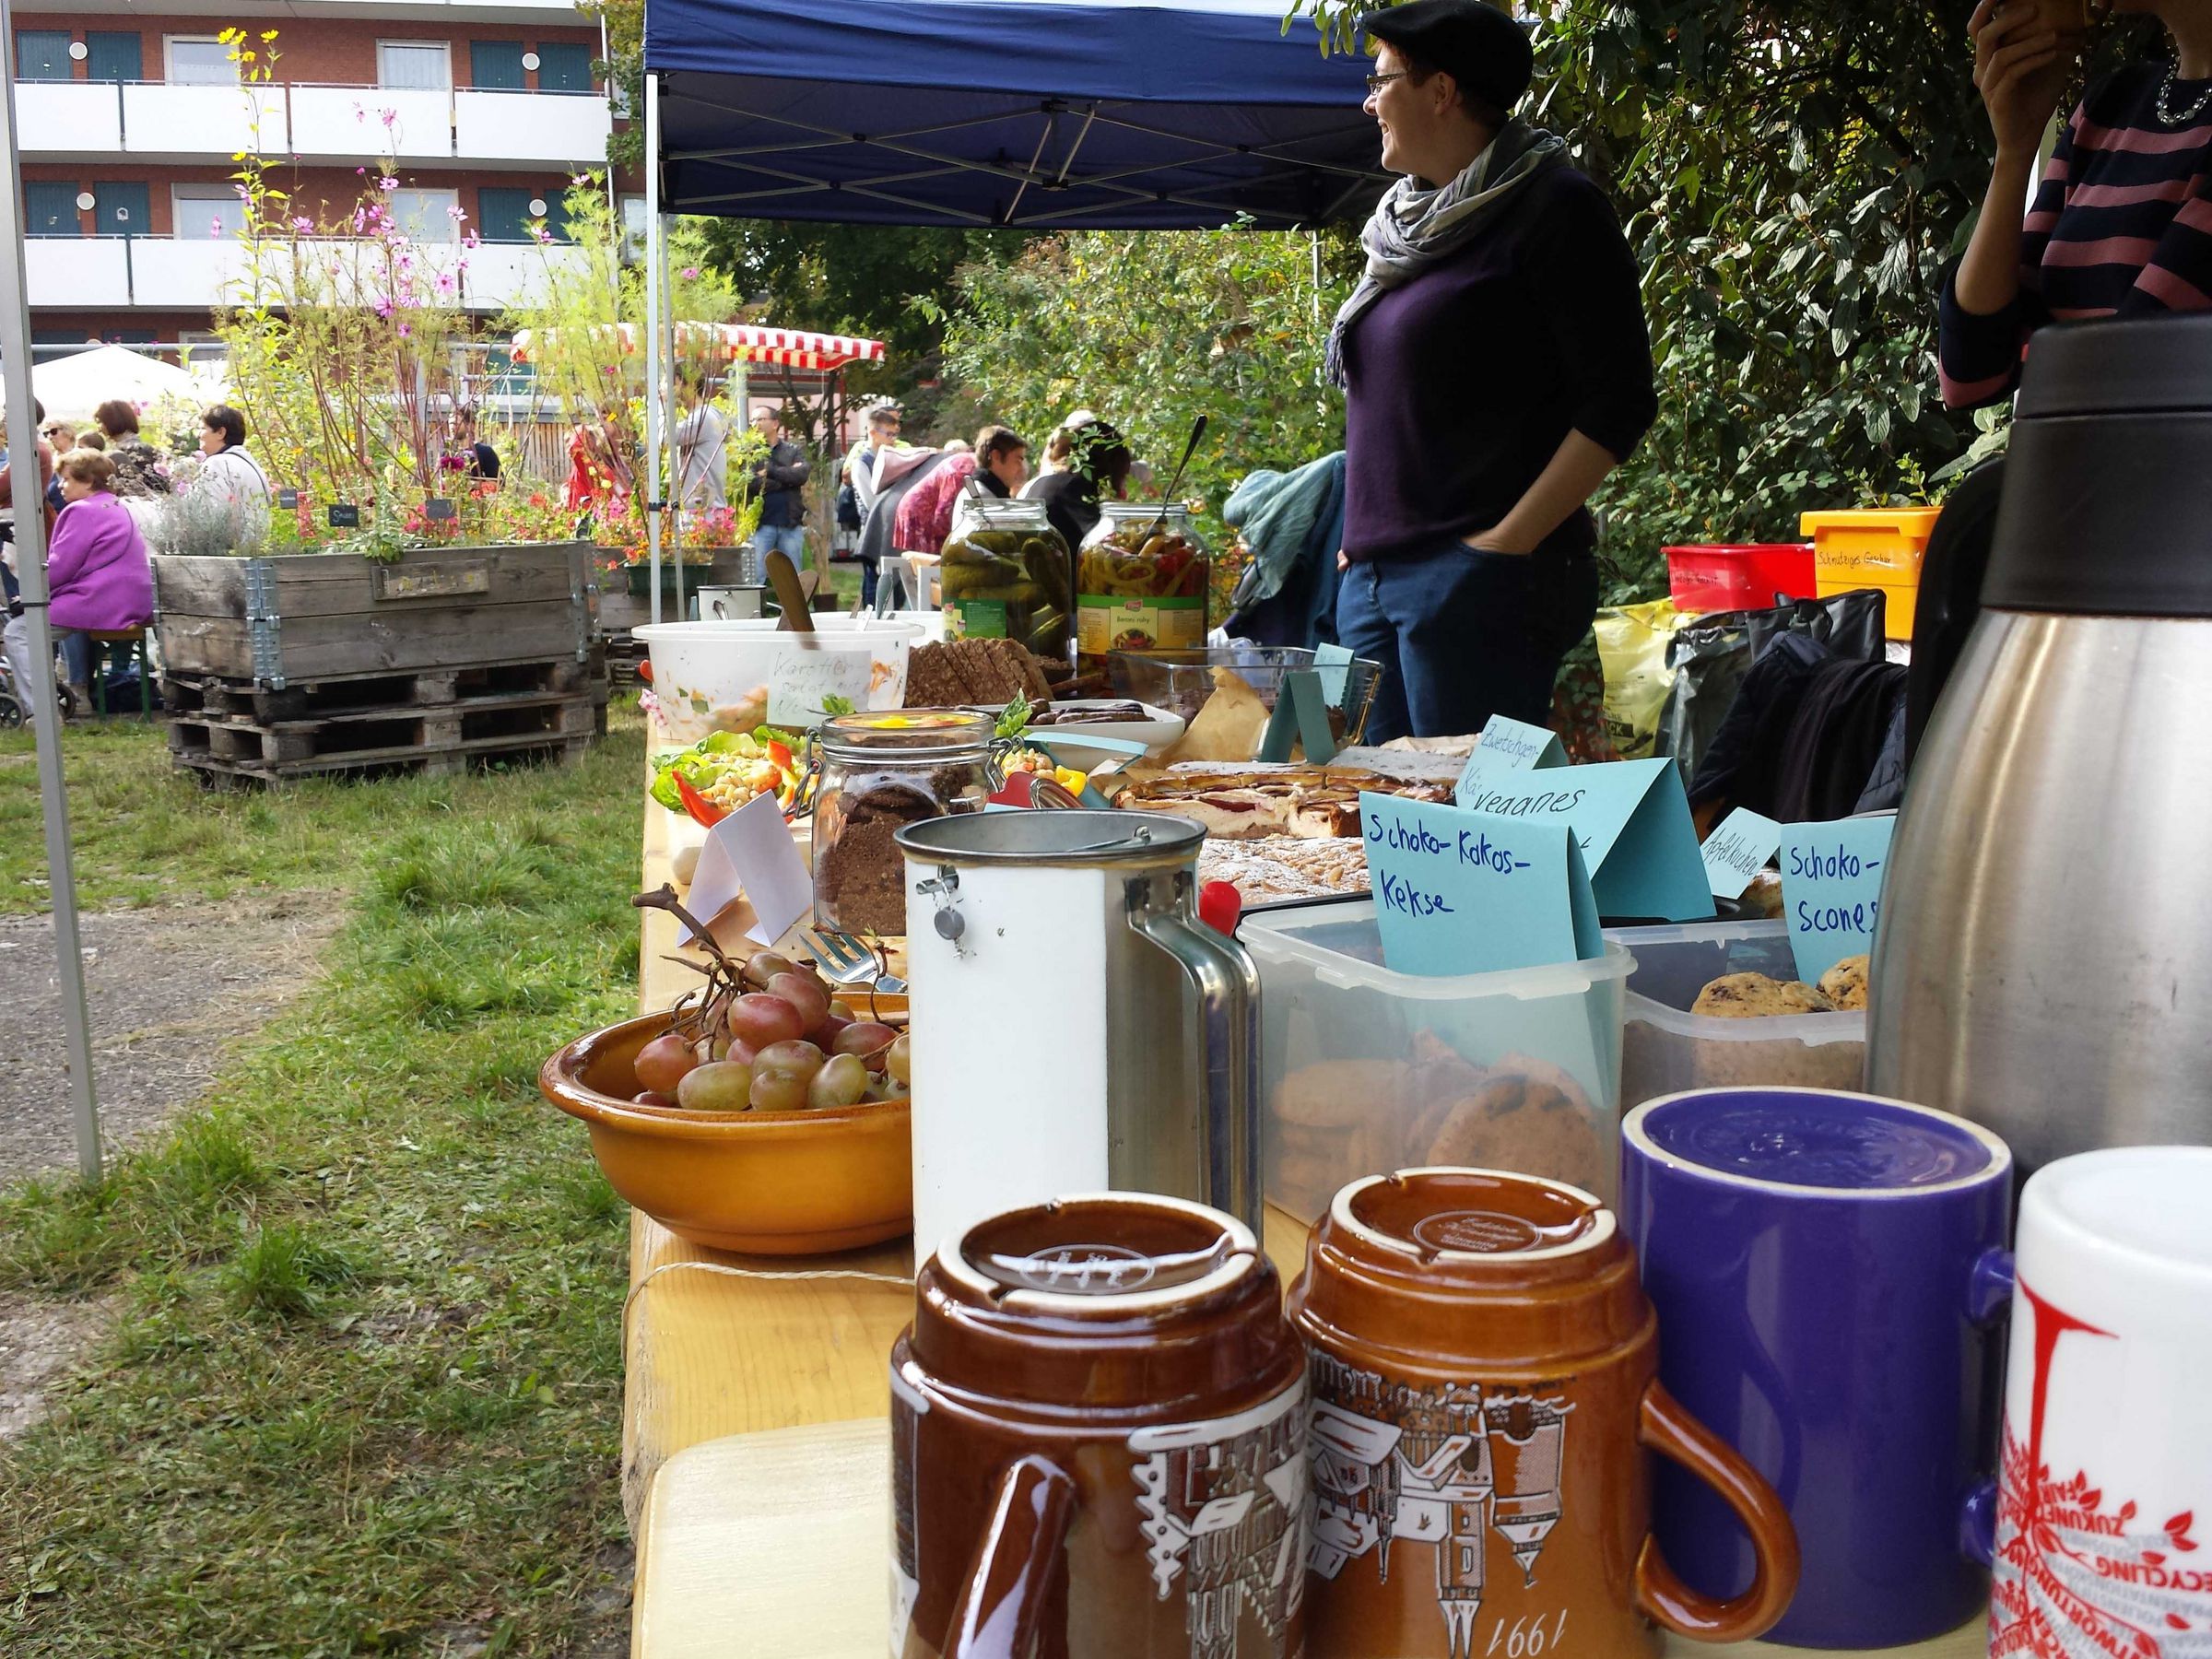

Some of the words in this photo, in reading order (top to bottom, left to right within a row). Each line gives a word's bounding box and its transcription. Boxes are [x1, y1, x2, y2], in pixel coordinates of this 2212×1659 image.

[1790, 843, 1880, 880] Schoko-
[1380, 868, 1454, 917] Kekse
[1486, 1607, 1568, 1659] 1991
